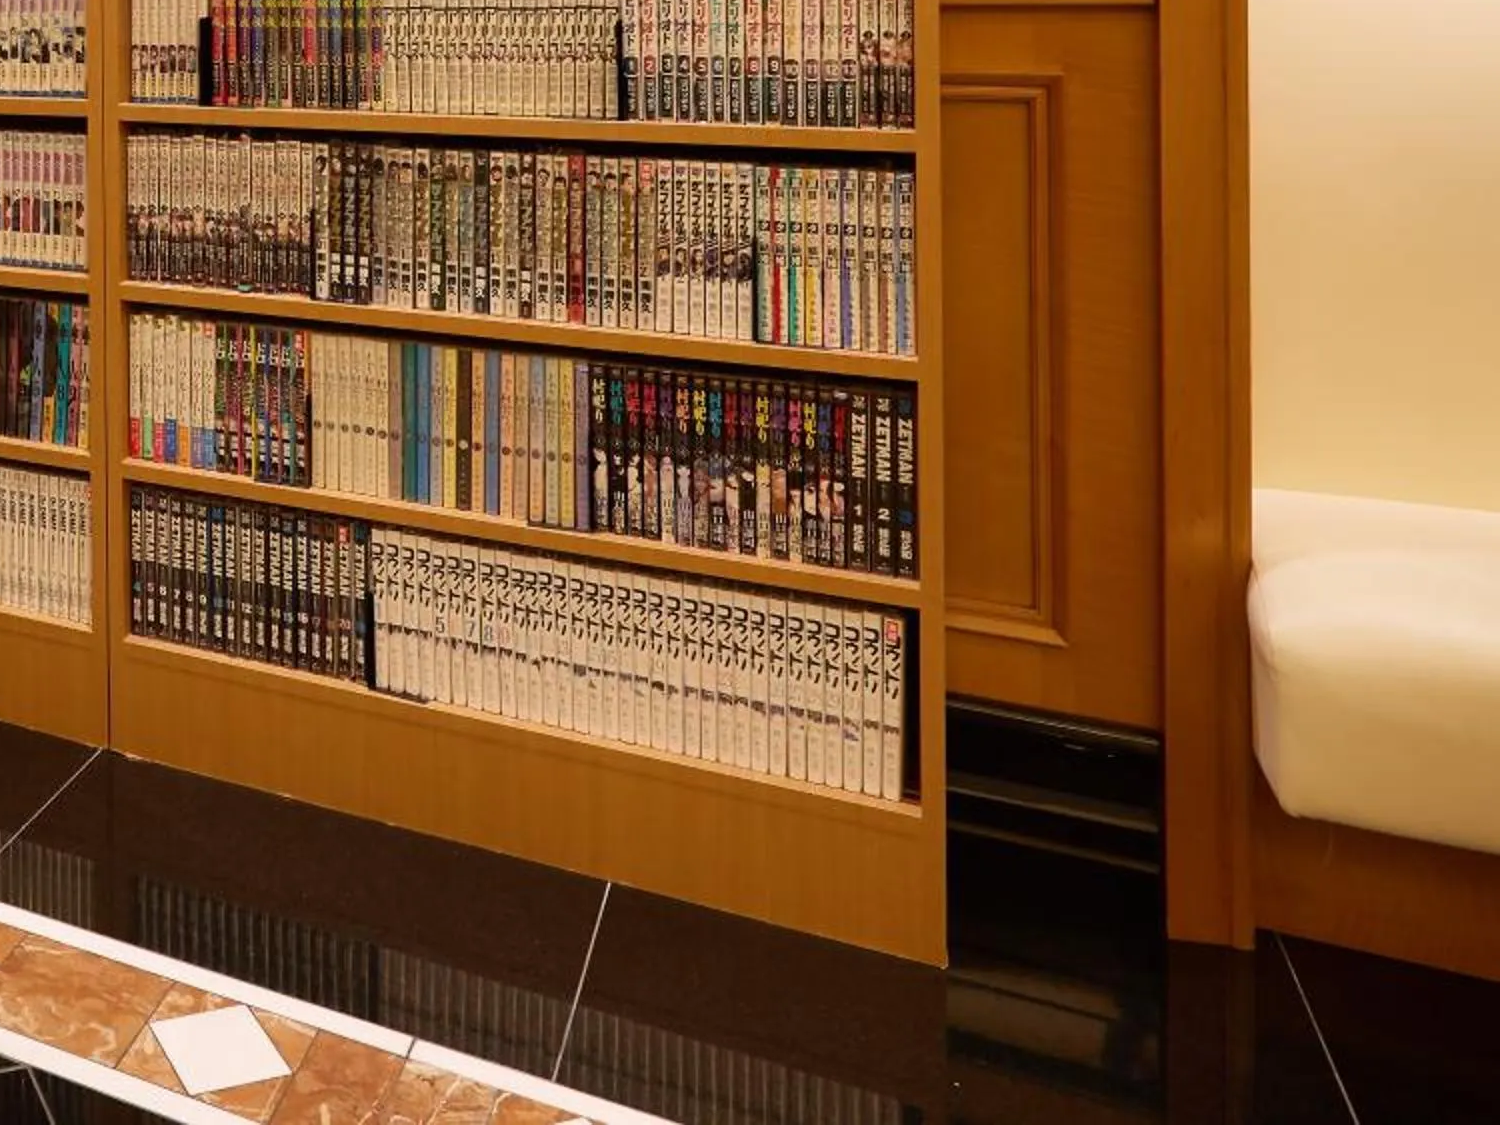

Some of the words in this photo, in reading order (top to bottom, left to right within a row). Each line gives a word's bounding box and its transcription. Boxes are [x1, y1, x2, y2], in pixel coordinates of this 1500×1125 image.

[852, 413, 866, 478] ZETMAN
[876, 417, 891, 482] ZETMAN
[898, 418, 913, 484] ZETMAN
[855, 505, 862, 517] 1
[878, 508, 890, 521] 2
